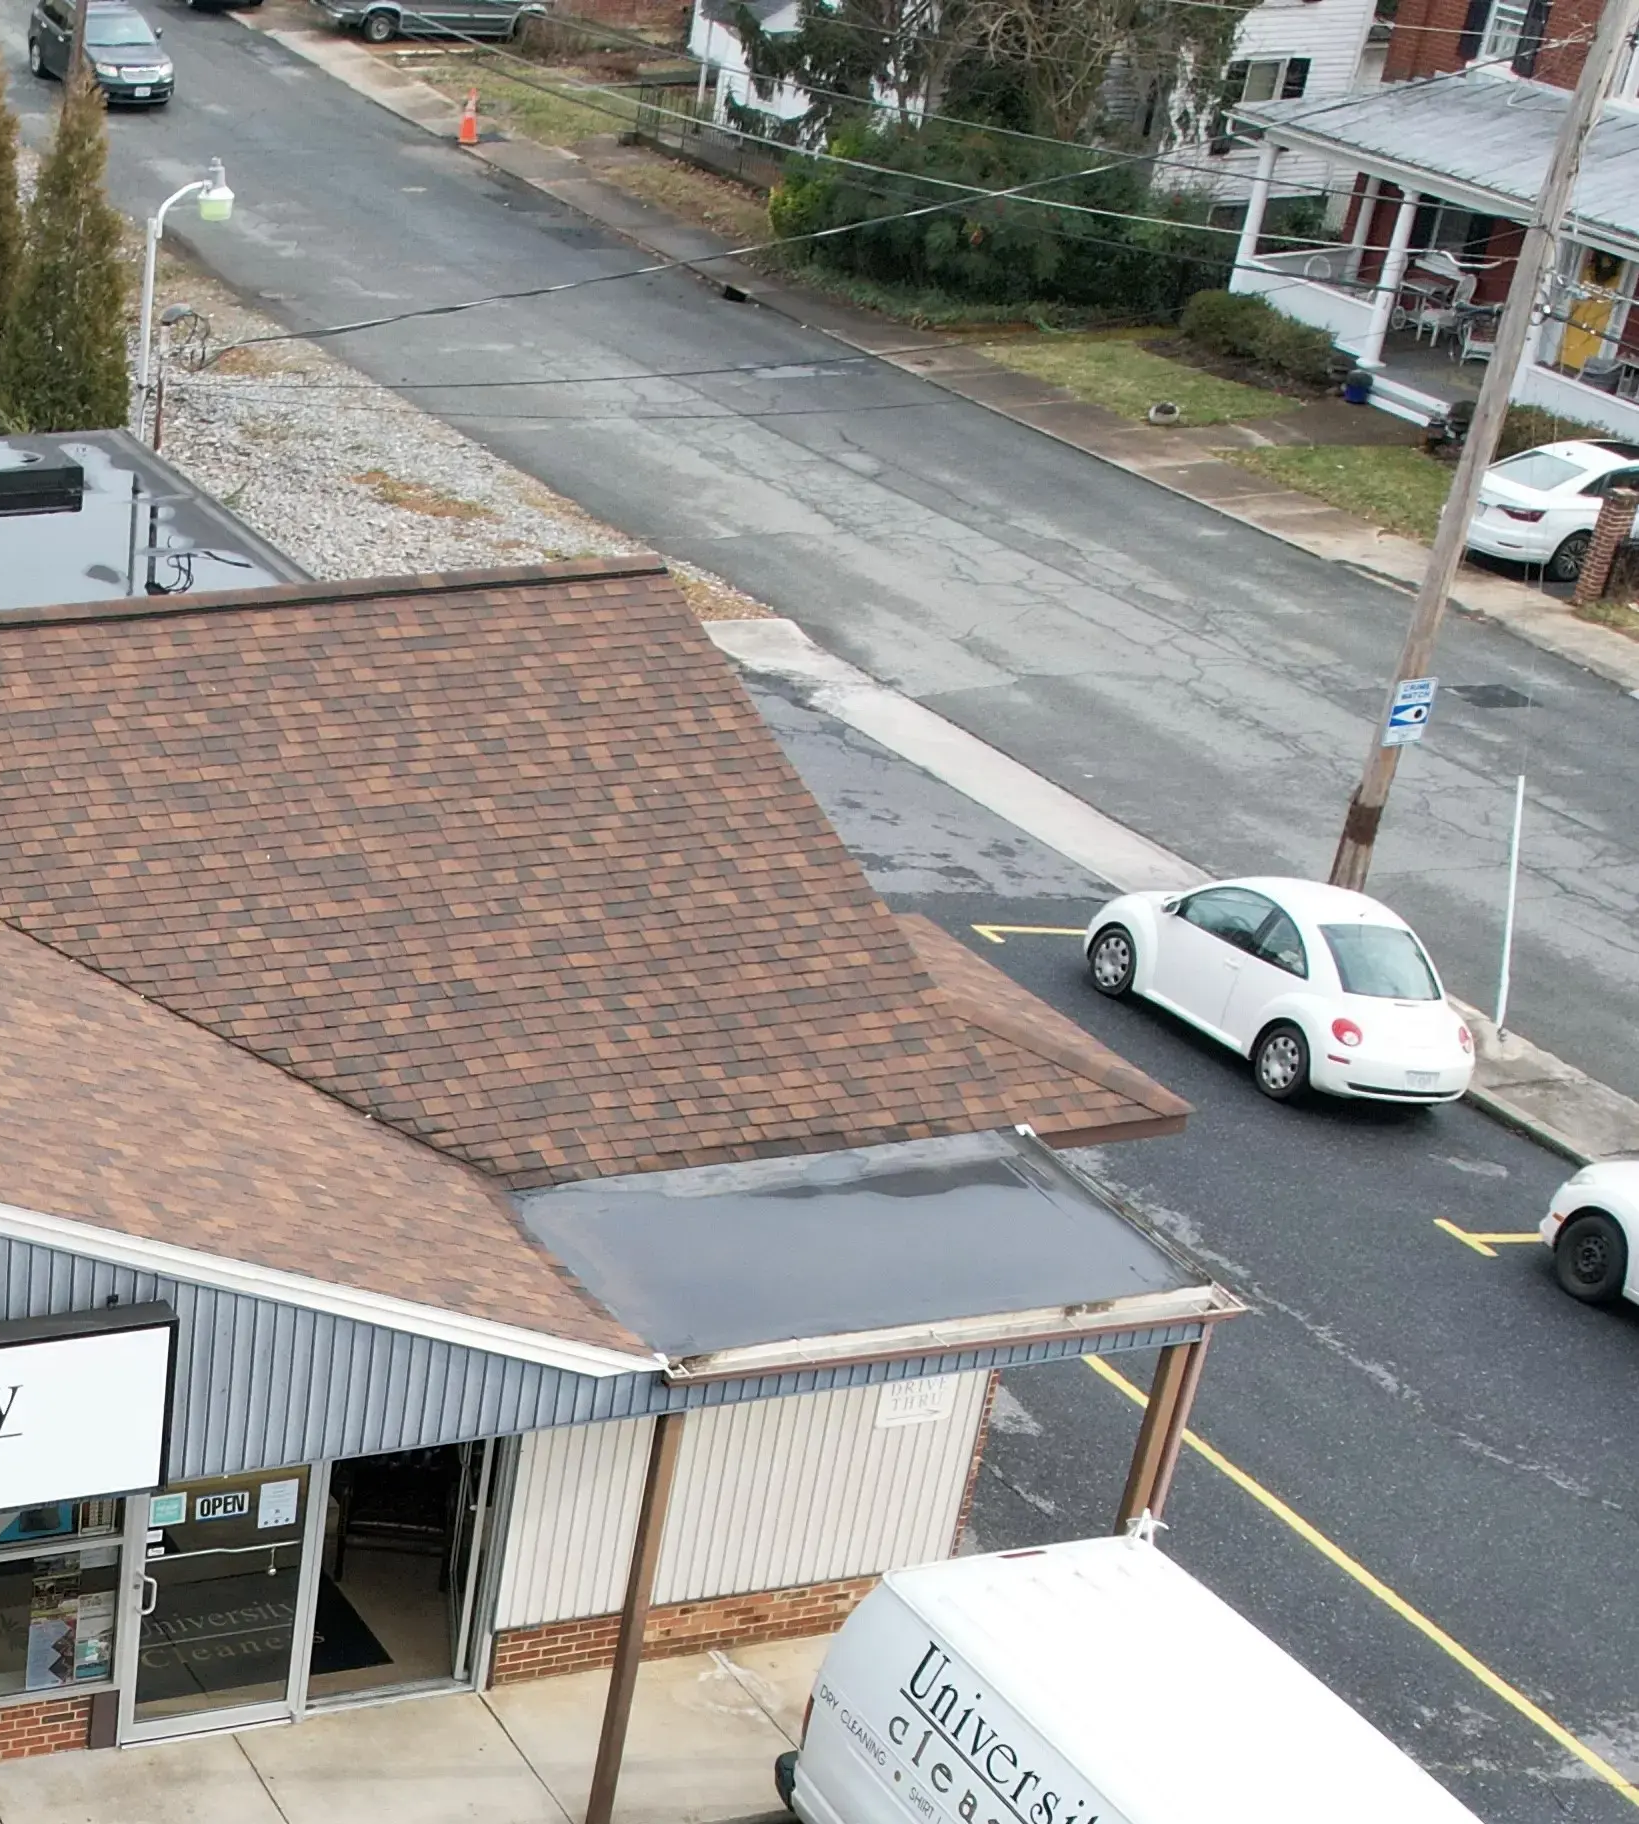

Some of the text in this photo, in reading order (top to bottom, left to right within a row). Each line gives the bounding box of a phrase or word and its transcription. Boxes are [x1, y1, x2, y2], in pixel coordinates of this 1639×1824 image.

[891, 1376, 947, 1397] DRIVE
[891, 1393, 944, 1411] THRU
[200, 1494, 245, 1518] OPEN
[141, 1631, 325, 1669] Cleanes
[820, 1684, 839, 1711] DRY
[840, 1708, 887, 1766] CLEANING
[908, 1786, 934, 1821] SHIRT
